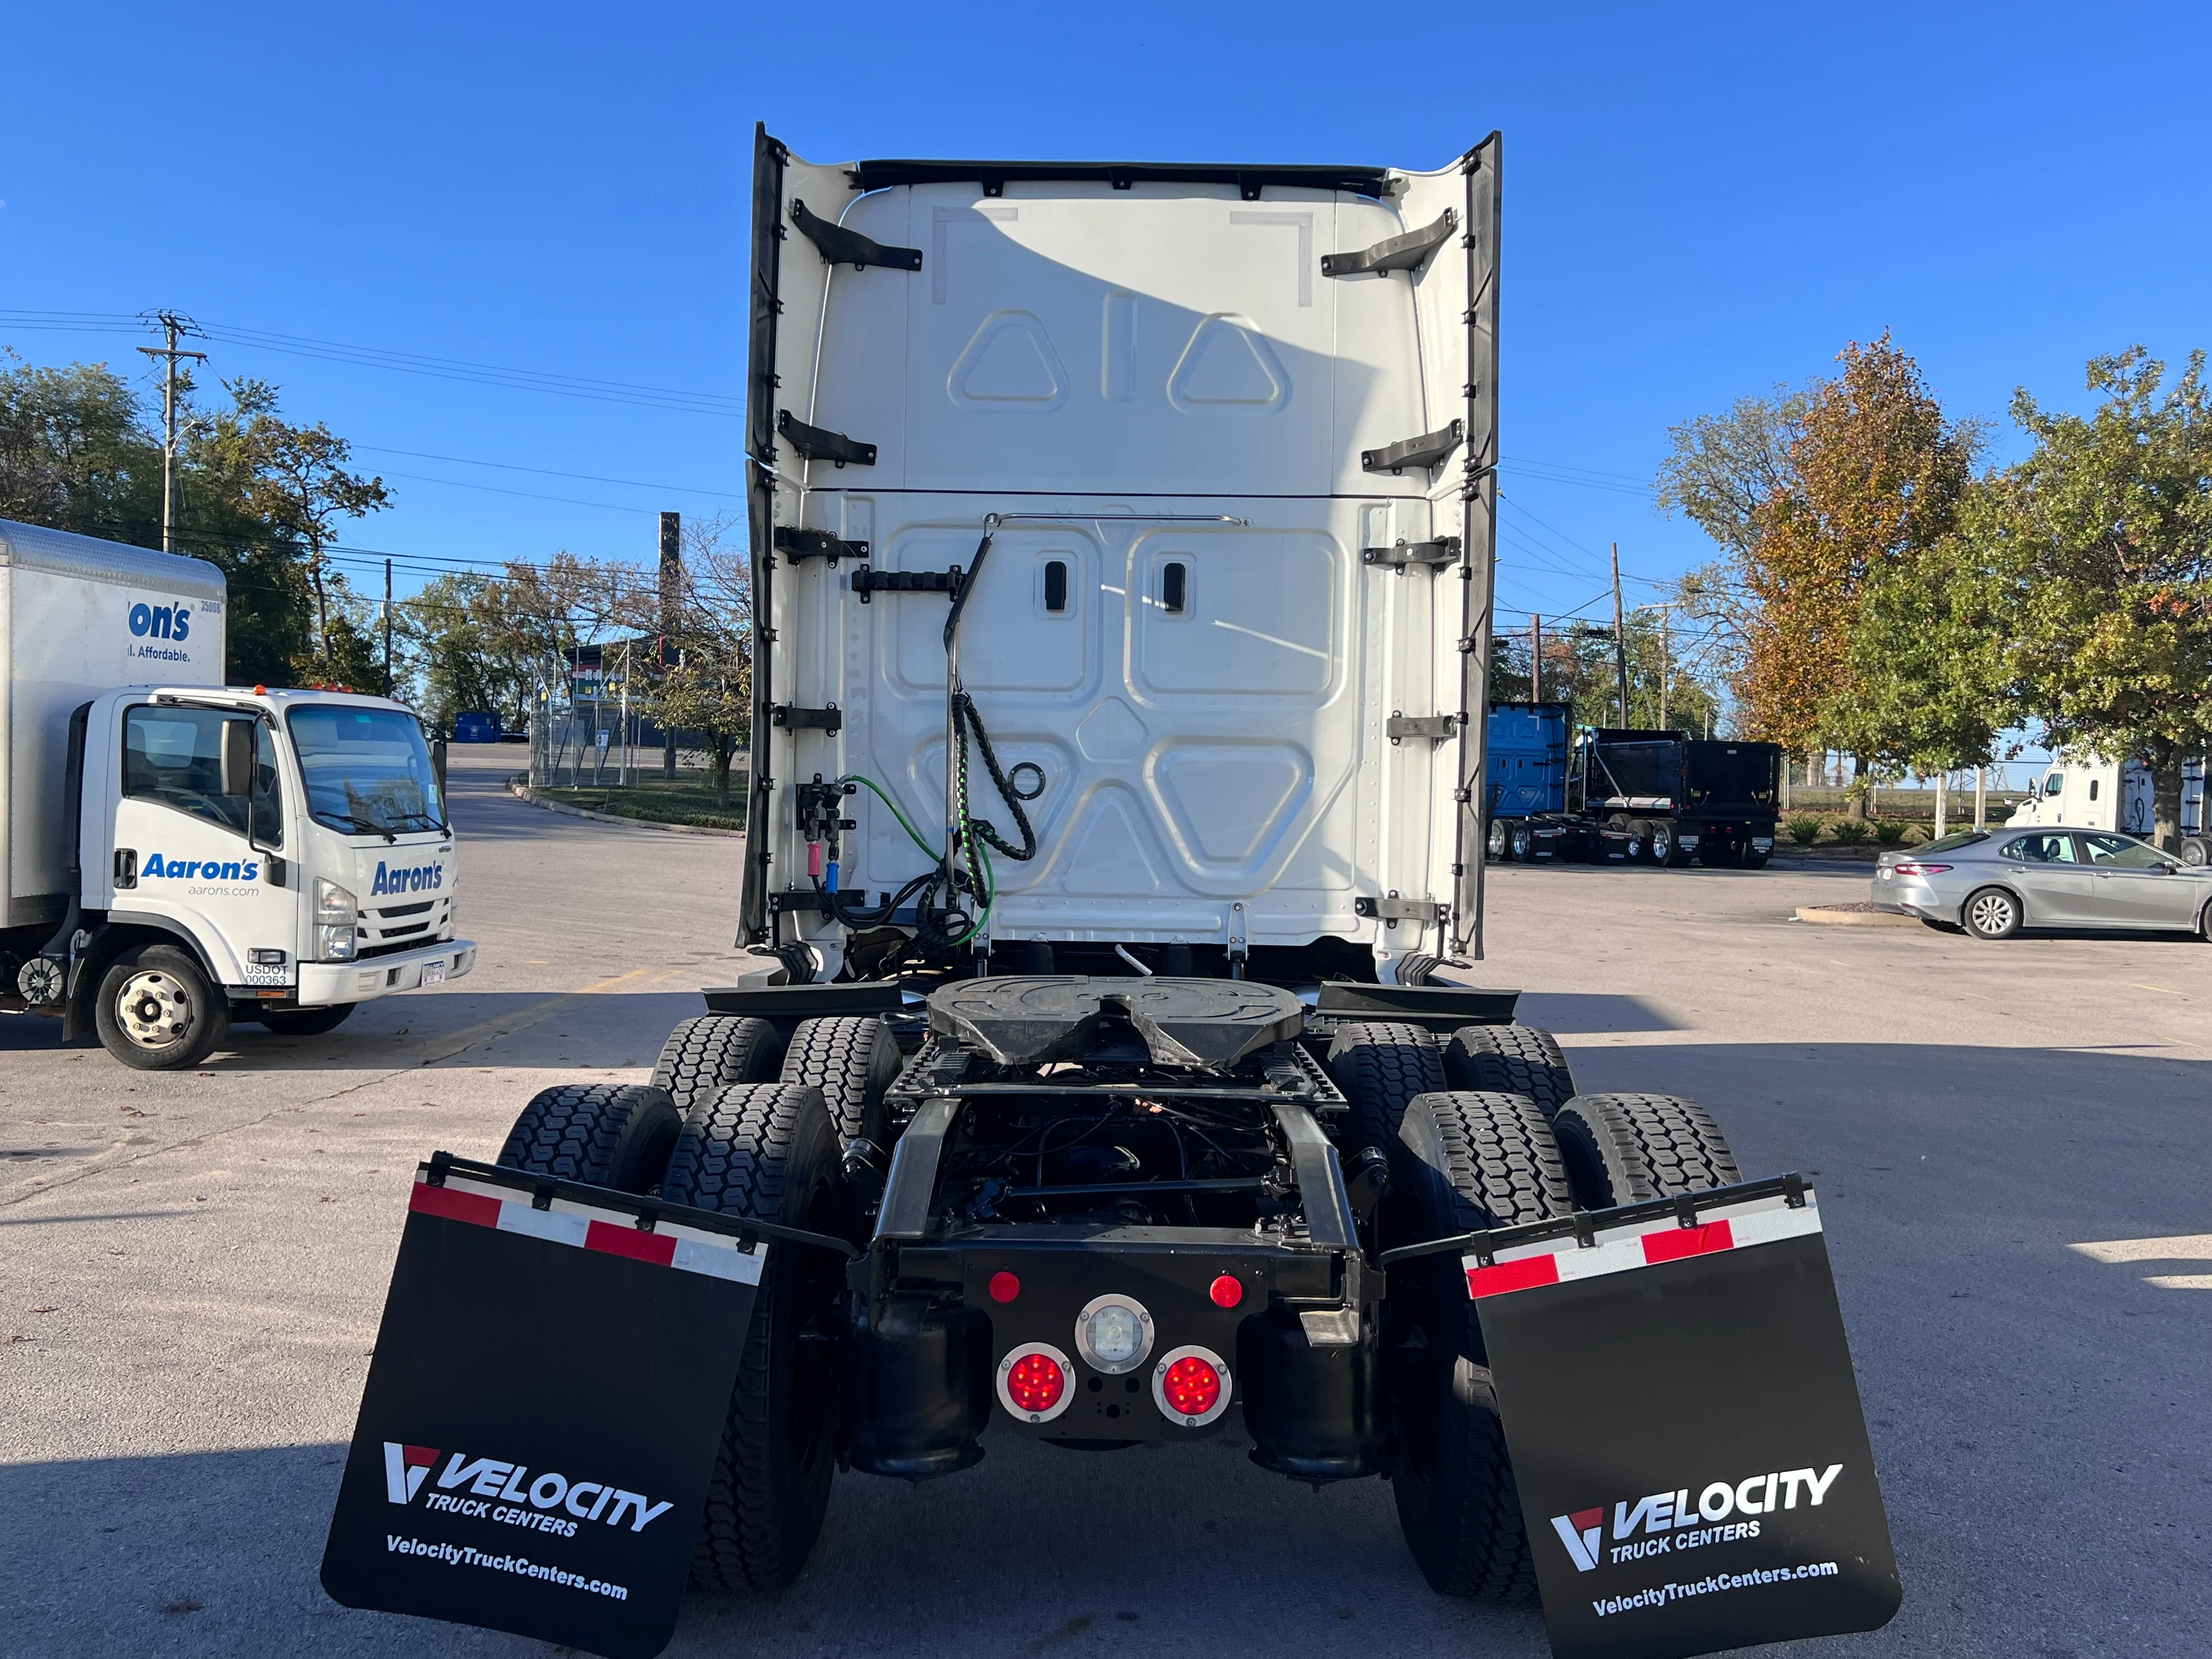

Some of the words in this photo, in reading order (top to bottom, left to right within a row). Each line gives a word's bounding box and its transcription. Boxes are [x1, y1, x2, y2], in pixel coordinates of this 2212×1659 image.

[201, 600, 221, 614] 35008
[138, 646, 190, 662] Affordable.
[140, 853, 259, 881] Aaron's
[370, 860, 442, 896] Aaron's
[189, 887, 259, 896] aarons.com
[246, 965, 288, 975] USDOT
[246, 975, 286, 985] 000363
[437, 1453, 674, 1532] VELOCITY
[1613, 1464, 1843, 1540] VELOCITY
[426, 1493, 492, 1518] TRUCK
[493, 1506, 578, 1537] CENTERS
[1611, 1536, 1671, 1564] TRUCK
[1676, 1520, 1760, 1550] CENTERS
[387, 1534, 628, 1601] VelocityTruckCenters.com
[1593, 1561, 1838, 1616] VelocityTruckCenters.com
